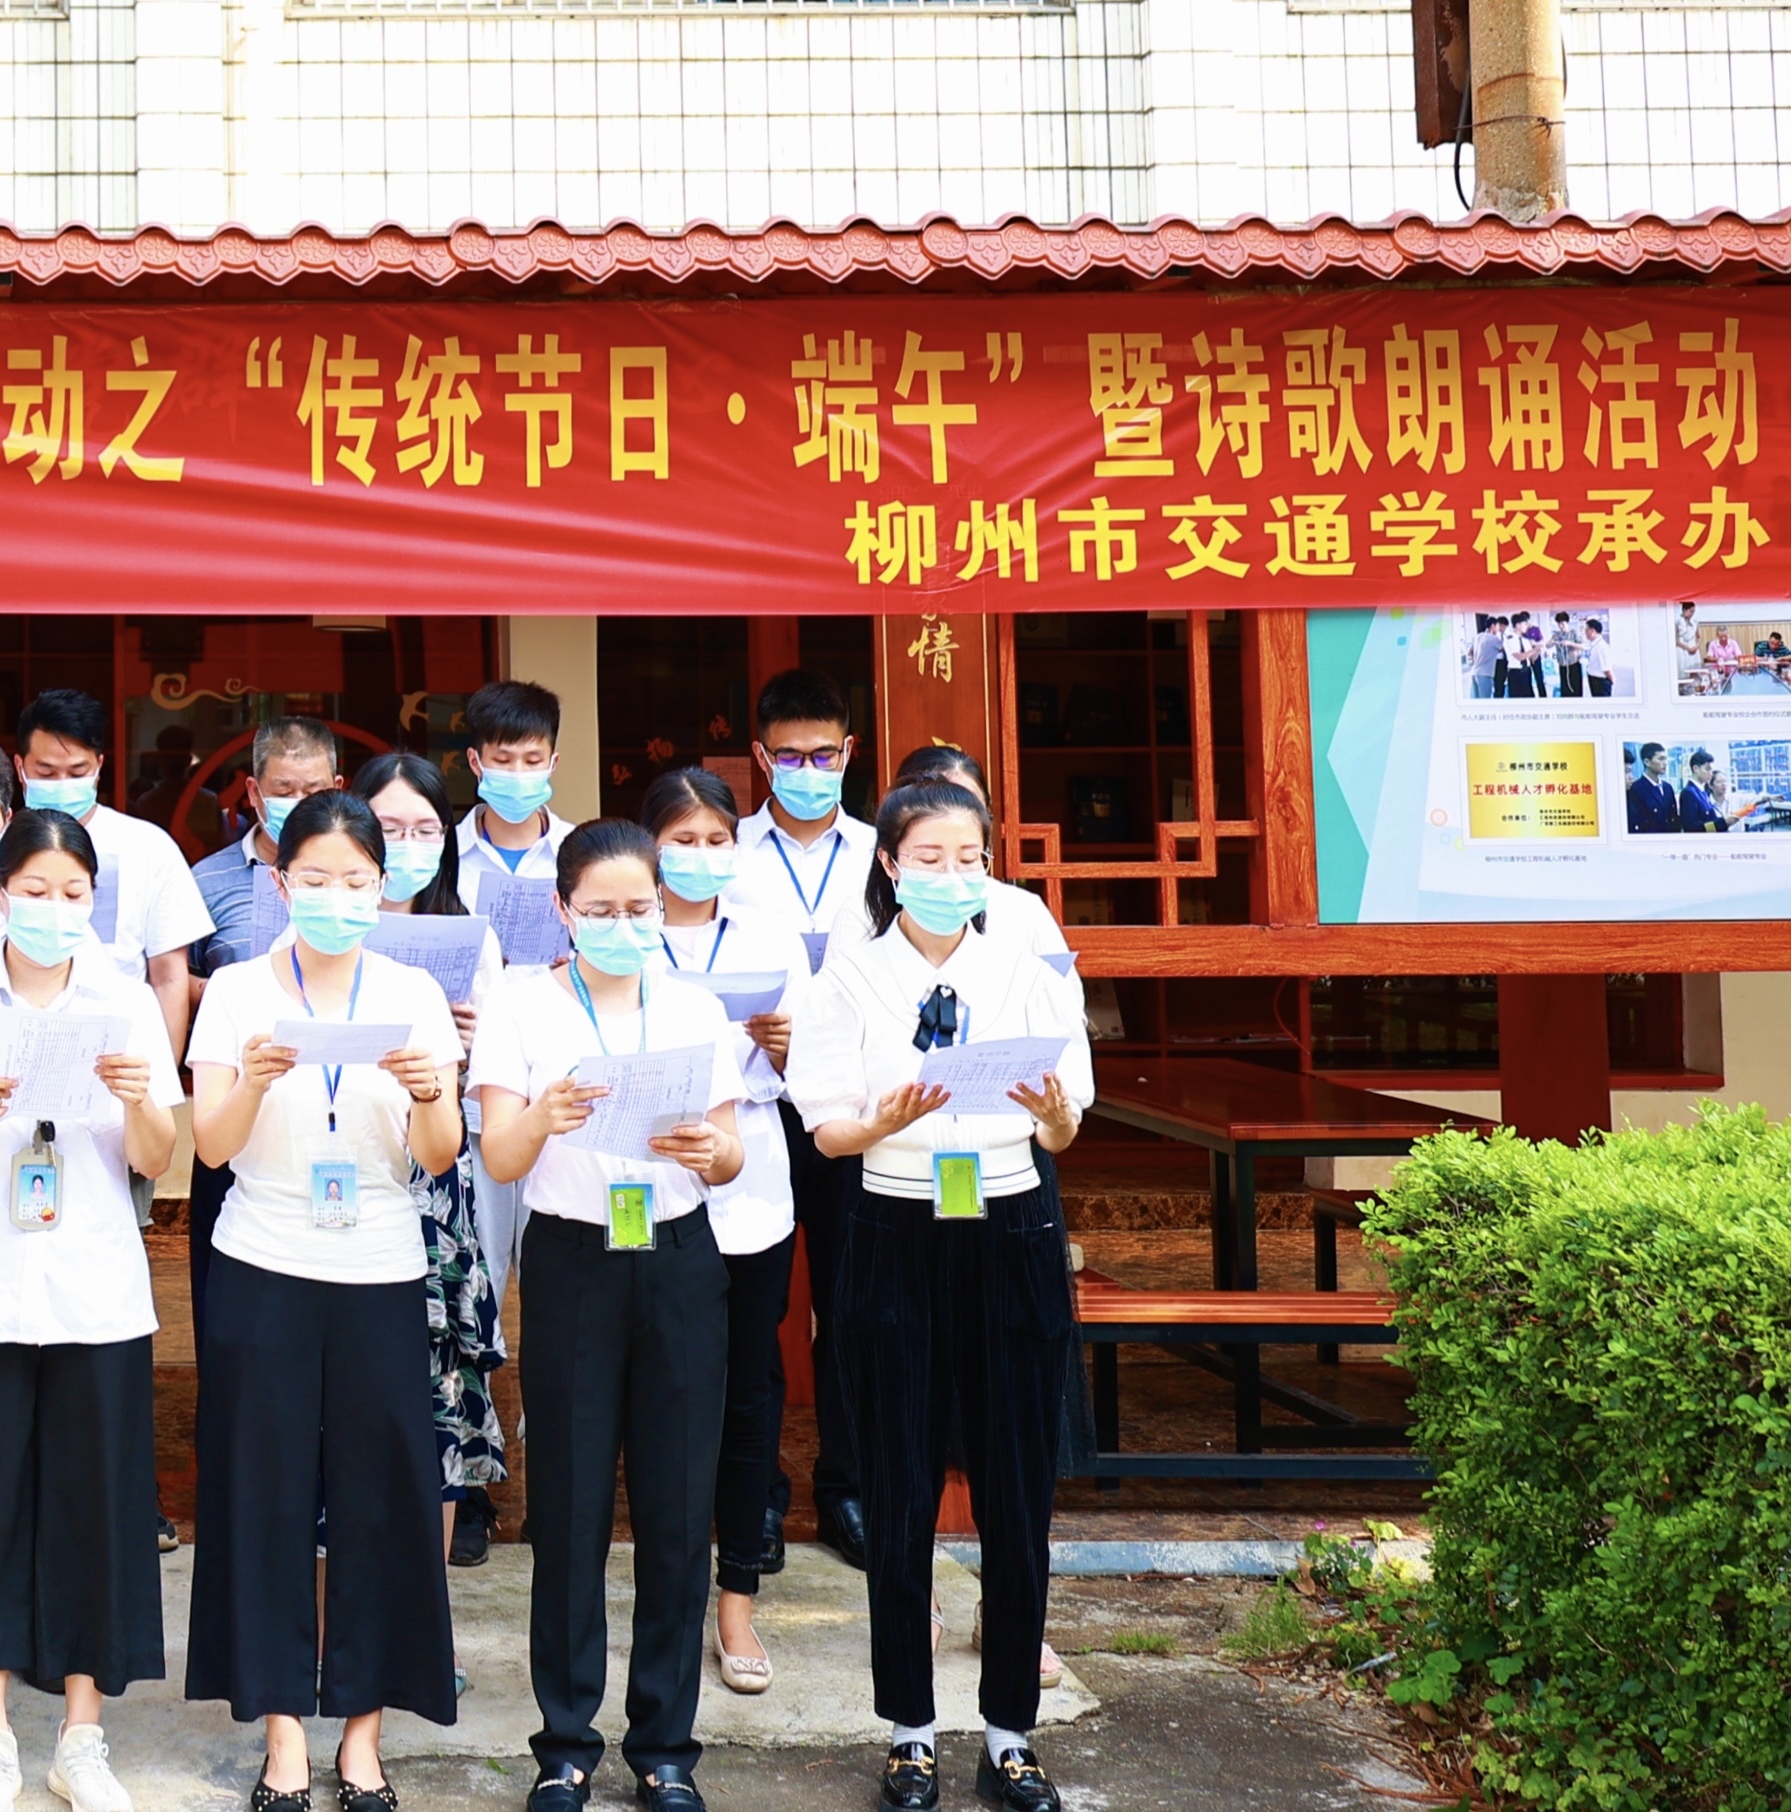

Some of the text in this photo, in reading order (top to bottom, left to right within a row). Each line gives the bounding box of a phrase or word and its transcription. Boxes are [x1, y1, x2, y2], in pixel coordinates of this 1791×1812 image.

[845, 485, 1771, 585] 柳州市交通学校承办
[1472, 783, 1593, 796] 工程机械人才孵化基地
